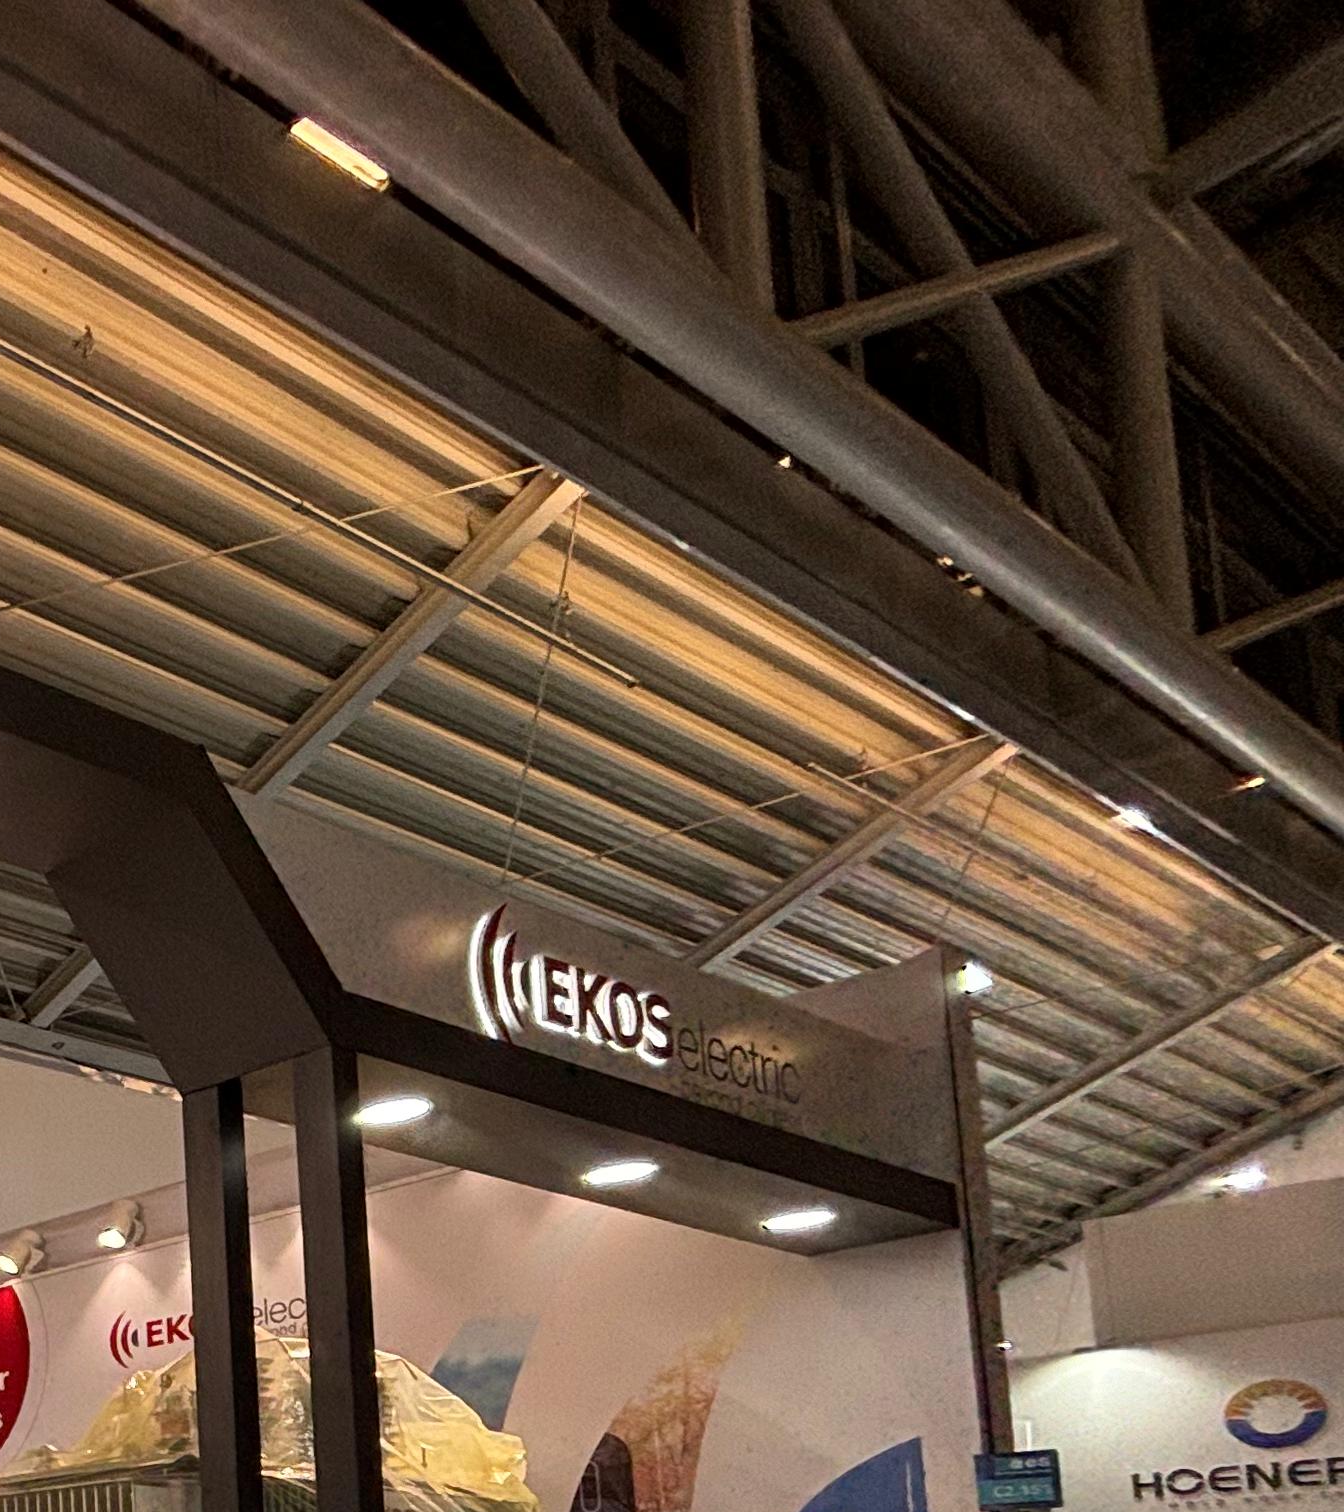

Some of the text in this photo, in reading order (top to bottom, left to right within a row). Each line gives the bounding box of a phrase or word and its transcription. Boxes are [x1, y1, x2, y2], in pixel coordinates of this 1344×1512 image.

[532, 953, 674, 1066] EKOS
[678, 1020, 802, 1103] electric
[146, 1313, 194, 1347] EK
